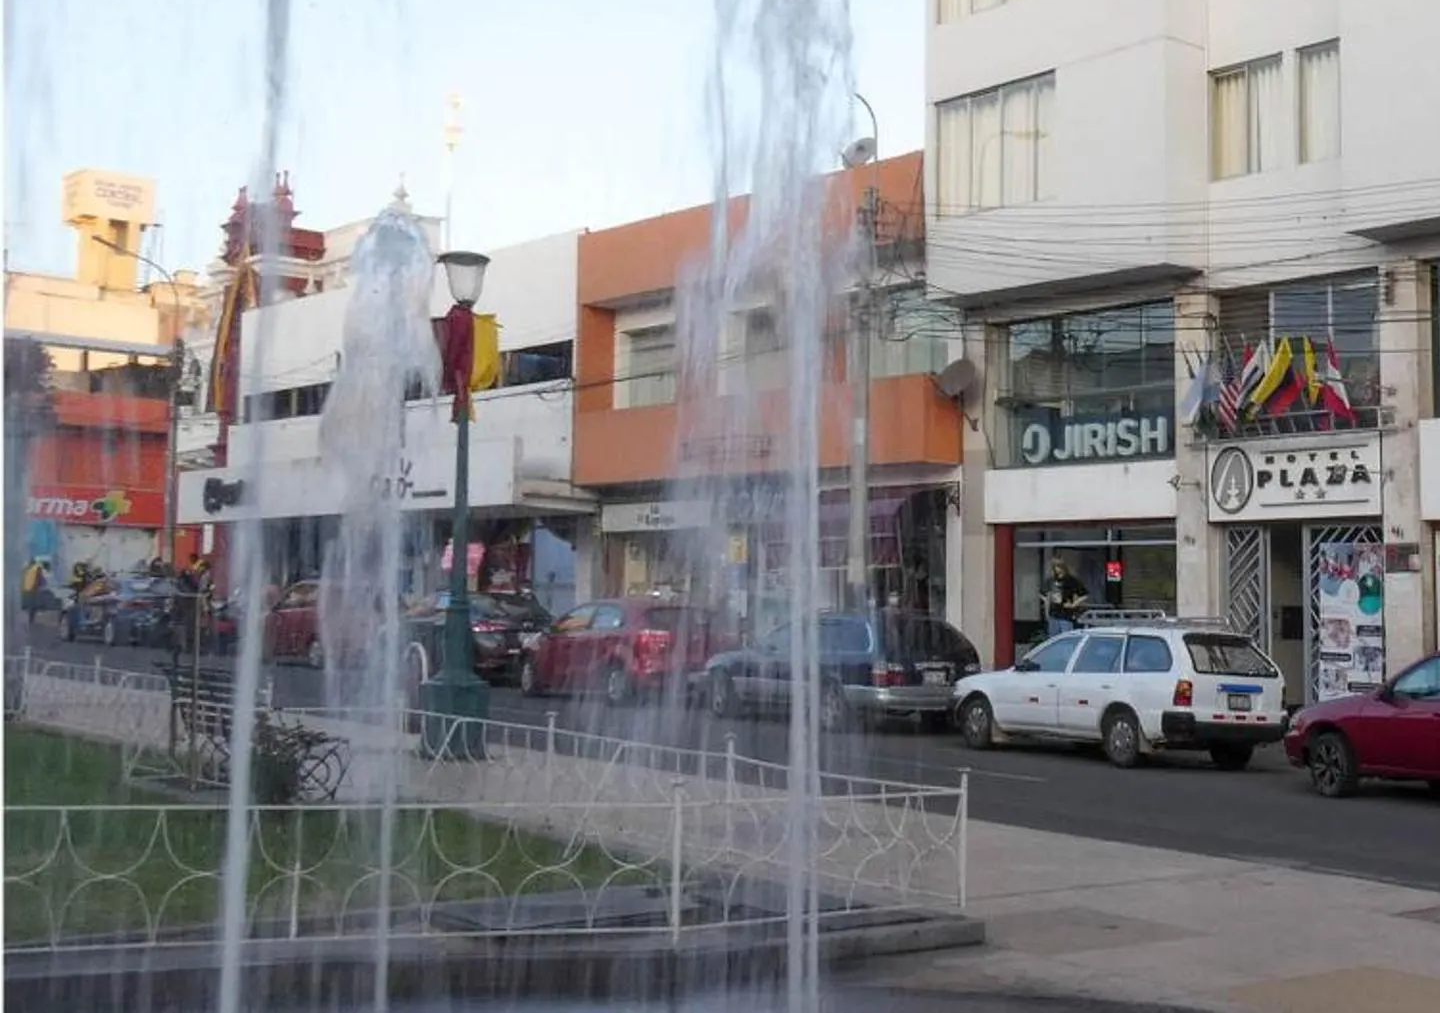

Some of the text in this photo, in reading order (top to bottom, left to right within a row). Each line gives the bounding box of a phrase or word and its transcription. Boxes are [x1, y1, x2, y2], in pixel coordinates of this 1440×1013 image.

[1053, 415, 1168, 460] JIRISH
[1264, 450, 1360, 465] HOTEL
[1256, 463, 1372, 489] PLAZA
